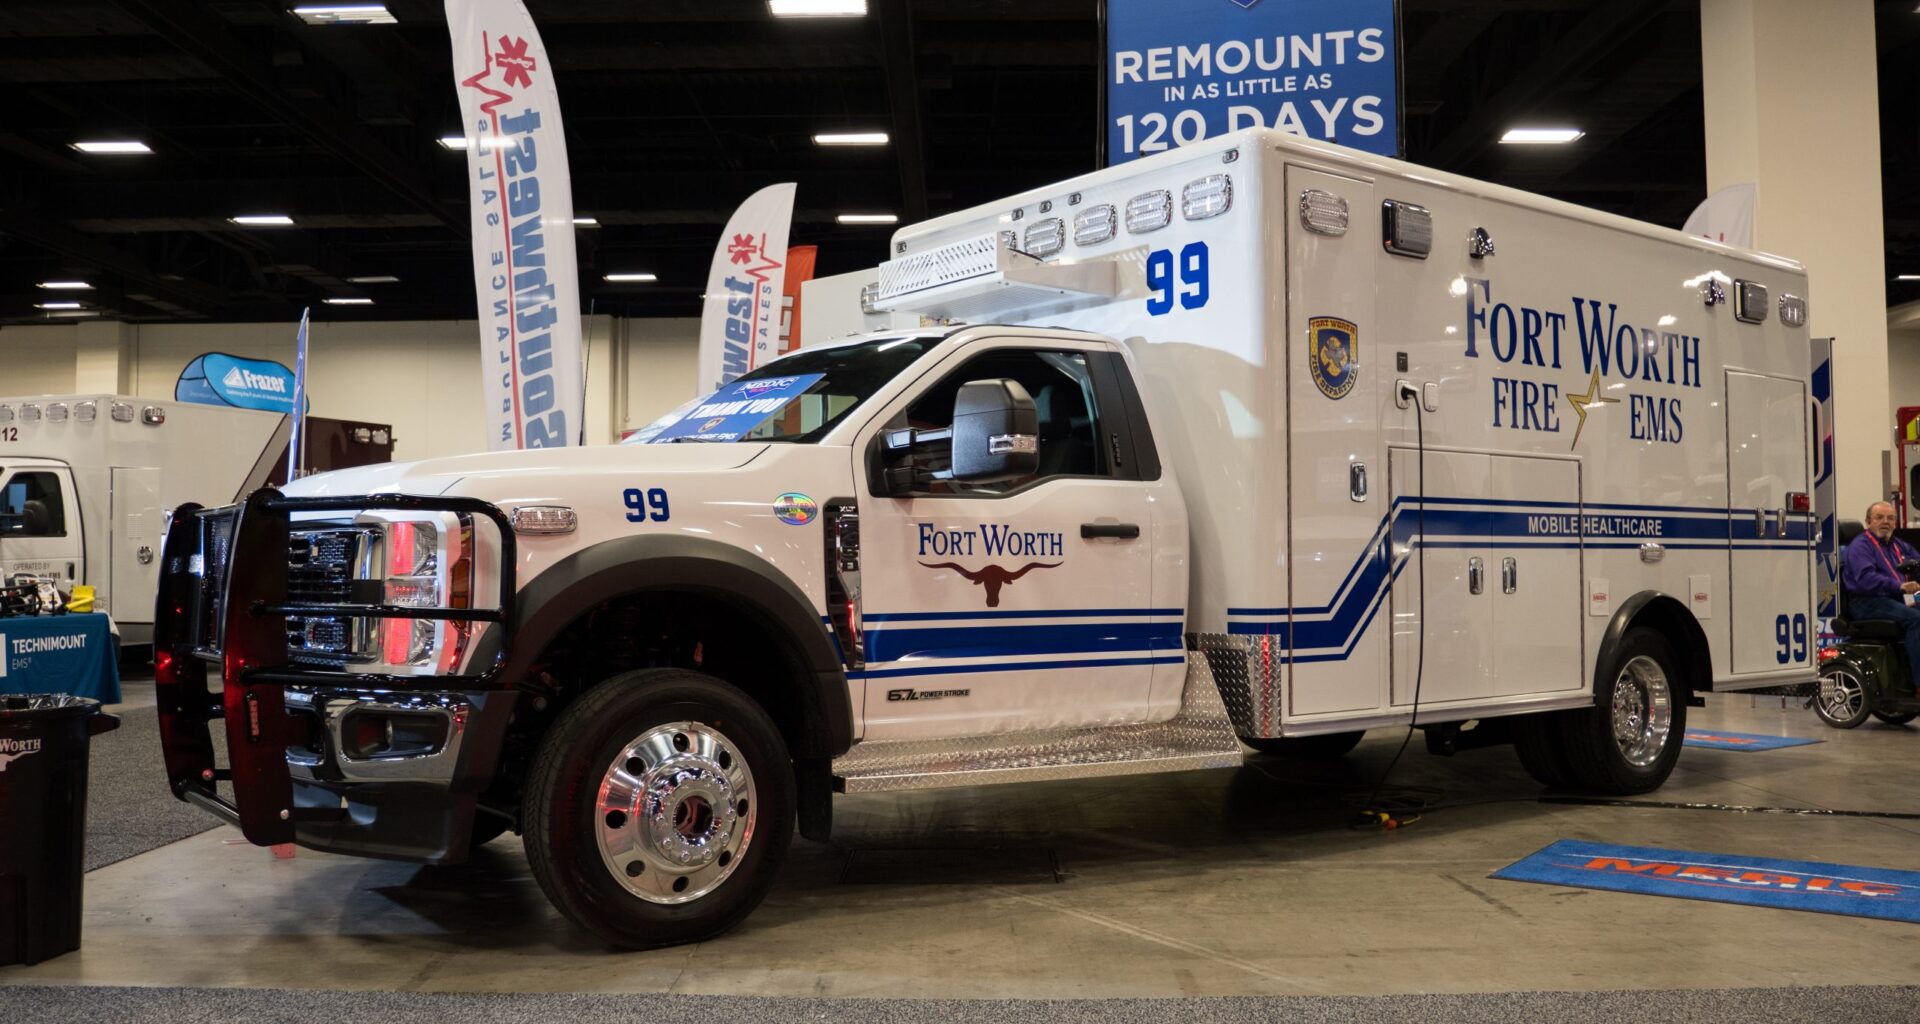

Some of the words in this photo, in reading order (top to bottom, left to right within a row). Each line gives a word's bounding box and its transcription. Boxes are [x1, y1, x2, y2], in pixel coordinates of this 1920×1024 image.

[1114, 28, 1386, 84] REMOUNTS
[1164, 85, 1185, 102] IN
[1191, 82, 1220, 100] AS
[1226, 76, 1297, 97] LITTLE
[1303, 73, 1333, 91] AS
[1116, 109, 1207, 153] 120
[1227, 95, 1385, 138] DAYS
[1146, 240, 1210, 317] 99
[757, 285, 772, 350] SALES
[1463, 276, 1566, 369] FORT
[1571, 296, 1702, 388] WORTH
[242, 369, 286, 393] Frazer
[742, 377, 797, 390] MEDIC
[686, 400, 746, 420] THANK
[742, 397, 790, 415] YOU
[1492, 377, 1561, 433] FIRE
[1629, 393, 1684, 444] EMS
[1, 427, 18, 442] 12
[622, 488, 671, 523] 99
[918, 523, 977, 556] FORT
[979, 524, 1064, 556] WORTH
[1528, 516, 1578, 534] MOBILE
[1583, 517, 1662, 535] HEALTHCARE
[13, 562, 43, 571] OPERATED
[43, 562, 51, 570] BY
[12, 634, 87, 654] TECHNIMOUNT
[1775, 613, 1807, 664] 99
[887, 689, 919, 701] 6.7L
[920, 690, 943, 698] POWER
[944, 689, 970, 697] STROKE
[0, 738, 41, 752] WORTH
[1583, 857, 1903, 894] MEDIC
